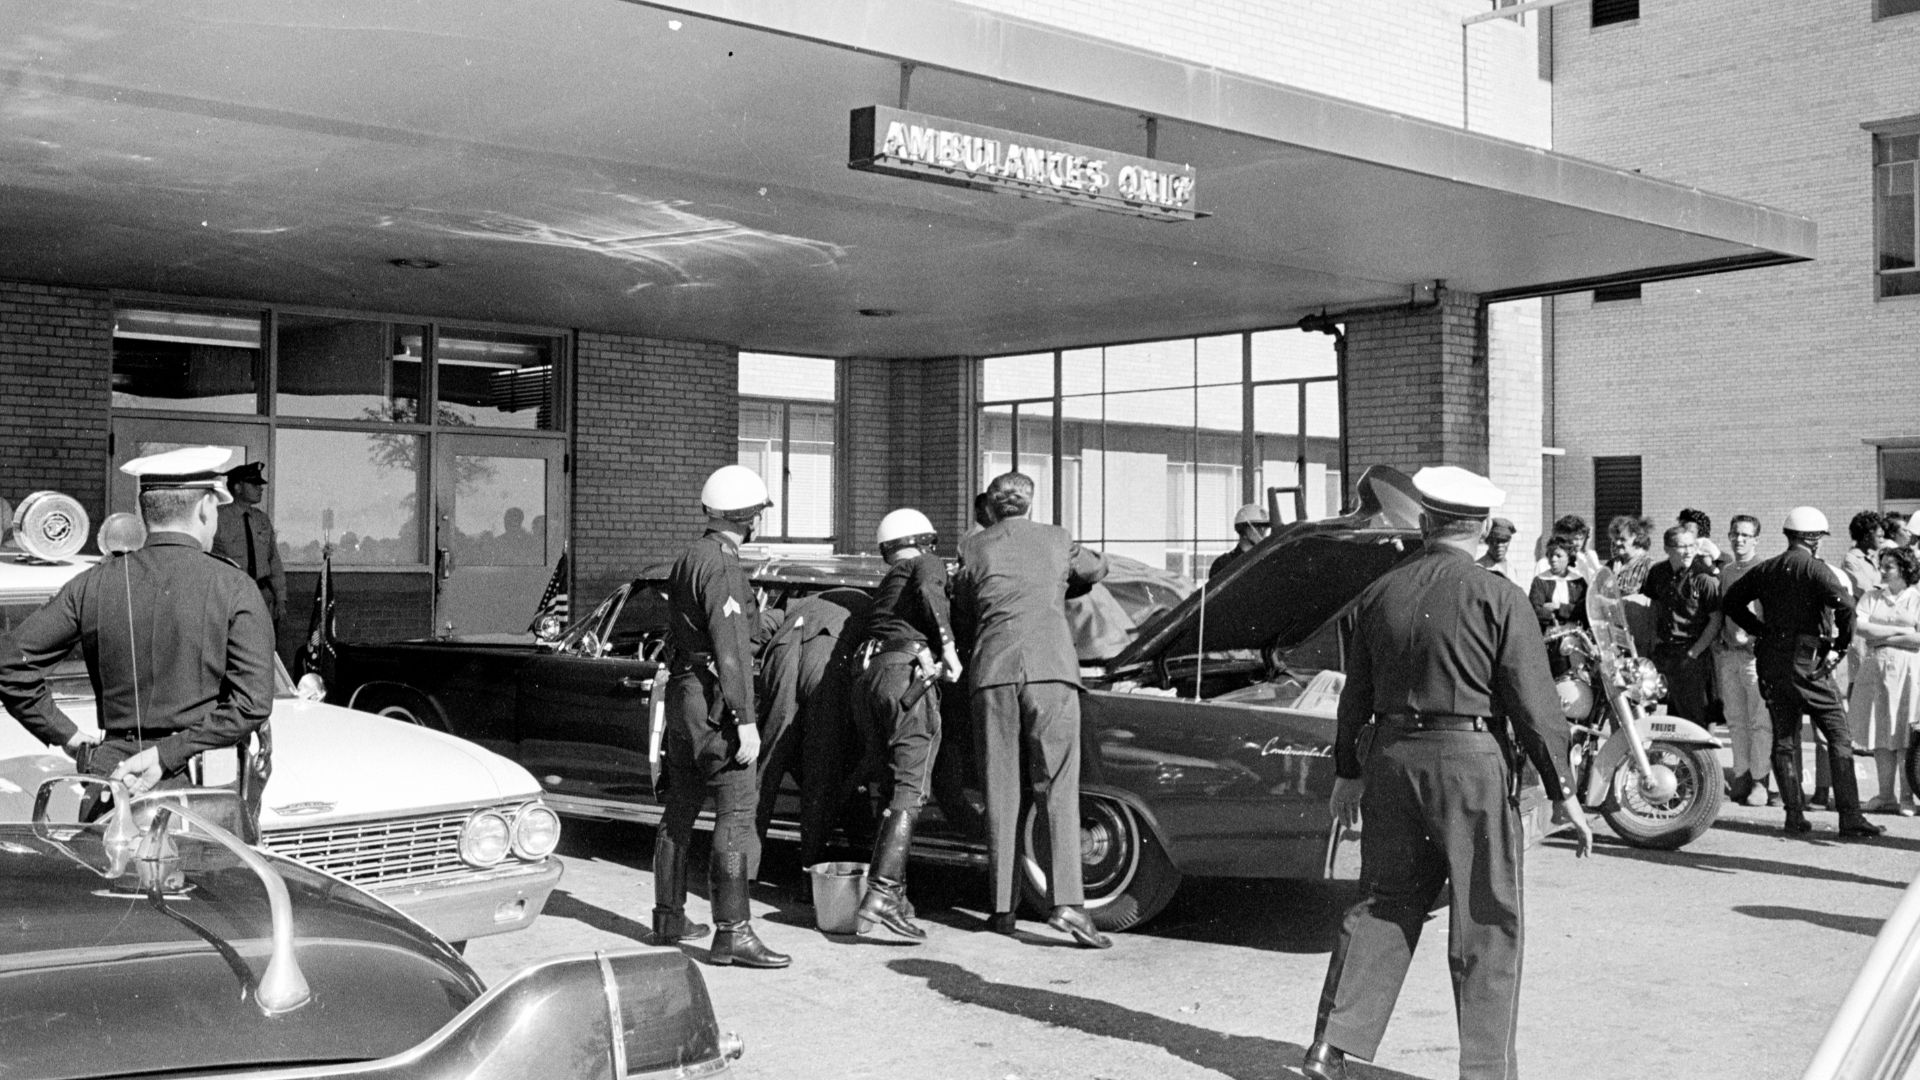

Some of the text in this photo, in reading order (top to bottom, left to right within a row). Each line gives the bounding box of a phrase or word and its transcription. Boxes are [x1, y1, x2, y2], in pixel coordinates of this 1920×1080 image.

[883, 121, 1195, 206] AMBULANCES ONLY
[1650, 723, 1676, 732] POLICE
